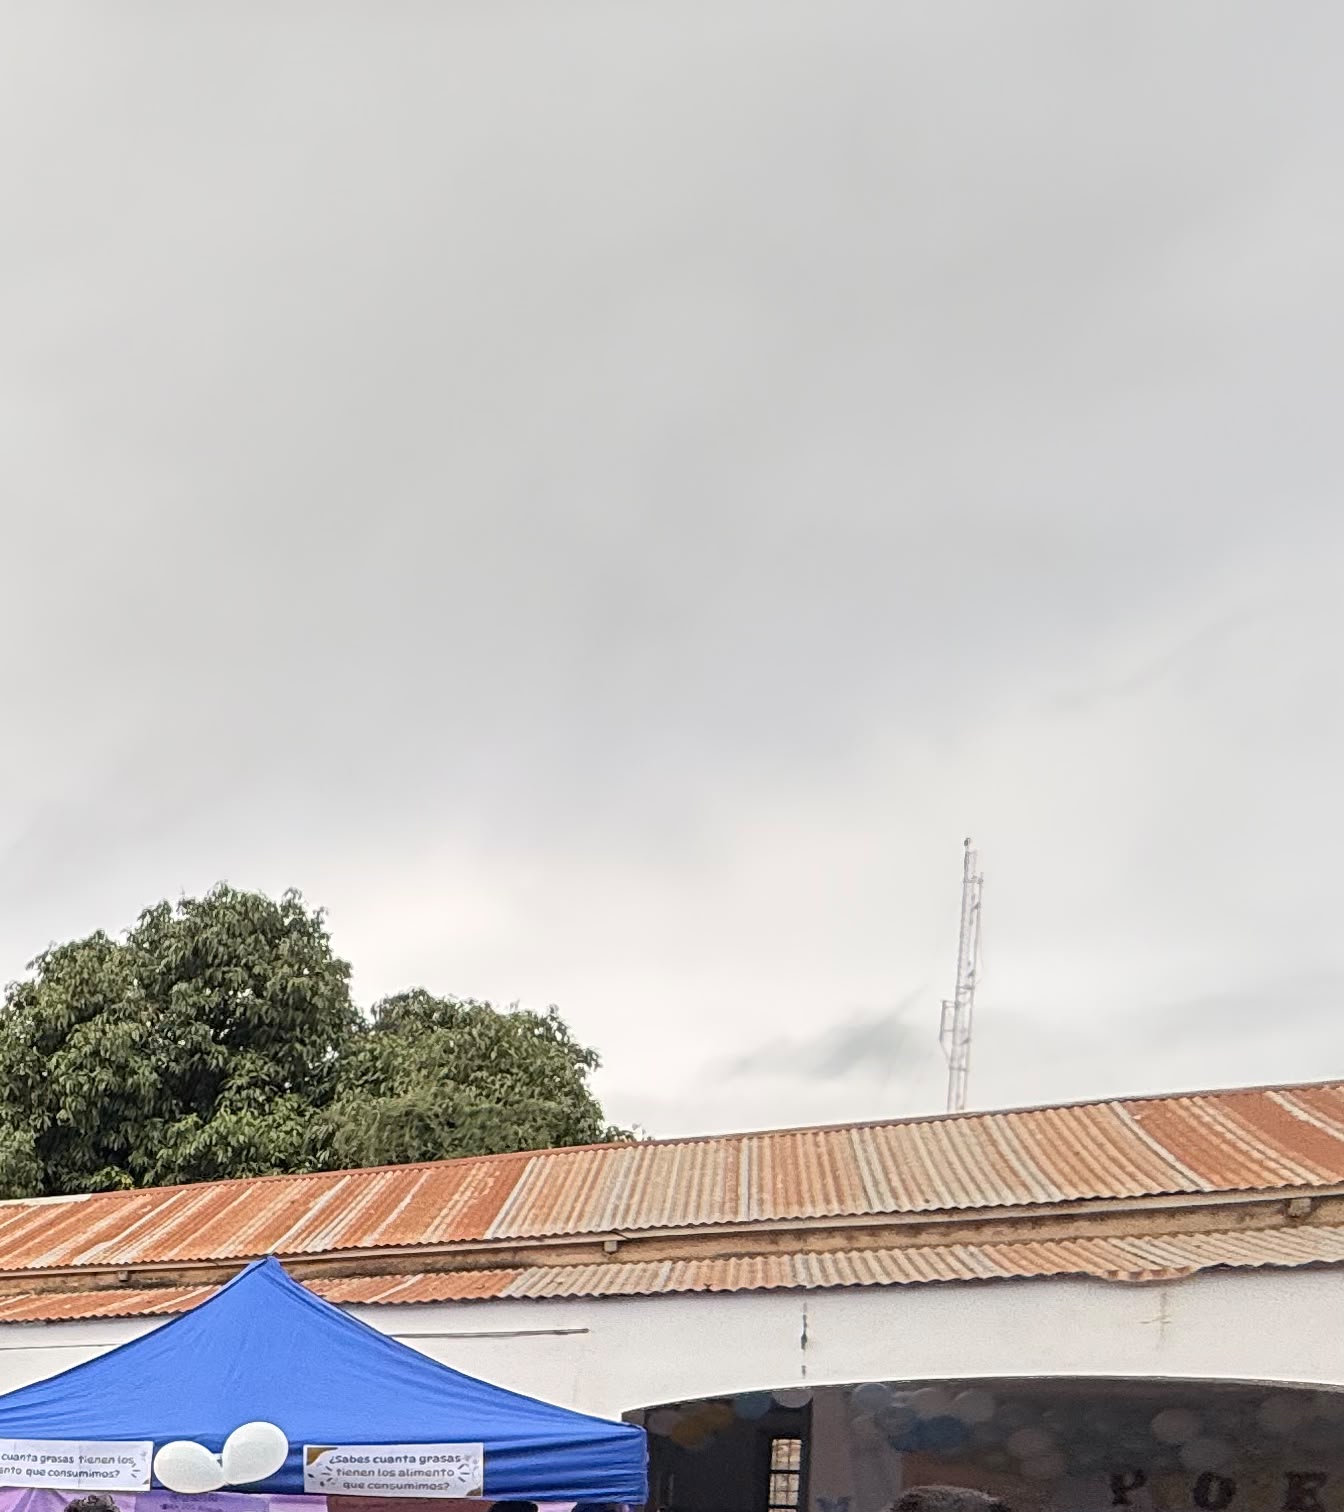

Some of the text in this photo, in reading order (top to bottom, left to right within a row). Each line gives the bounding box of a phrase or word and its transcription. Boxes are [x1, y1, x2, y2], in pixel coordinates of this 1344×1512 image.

[1, 1452, 38, 1463] cuanta
[40, 1454, 74, 1466] grasas
[78, 1454, 115, 1465] tienen
[117, 1455, 134, 1465] los
[329, 1454, 461, 1465] ¿Sabes cuanta grasas
[25, 1467, 46, 1478] que
[48, 1468, 120, 1479] consumimos?
[336, 1468, 454, 1477] tienen los alimento
[343, 1481, 450, 1491] que consumimos?
